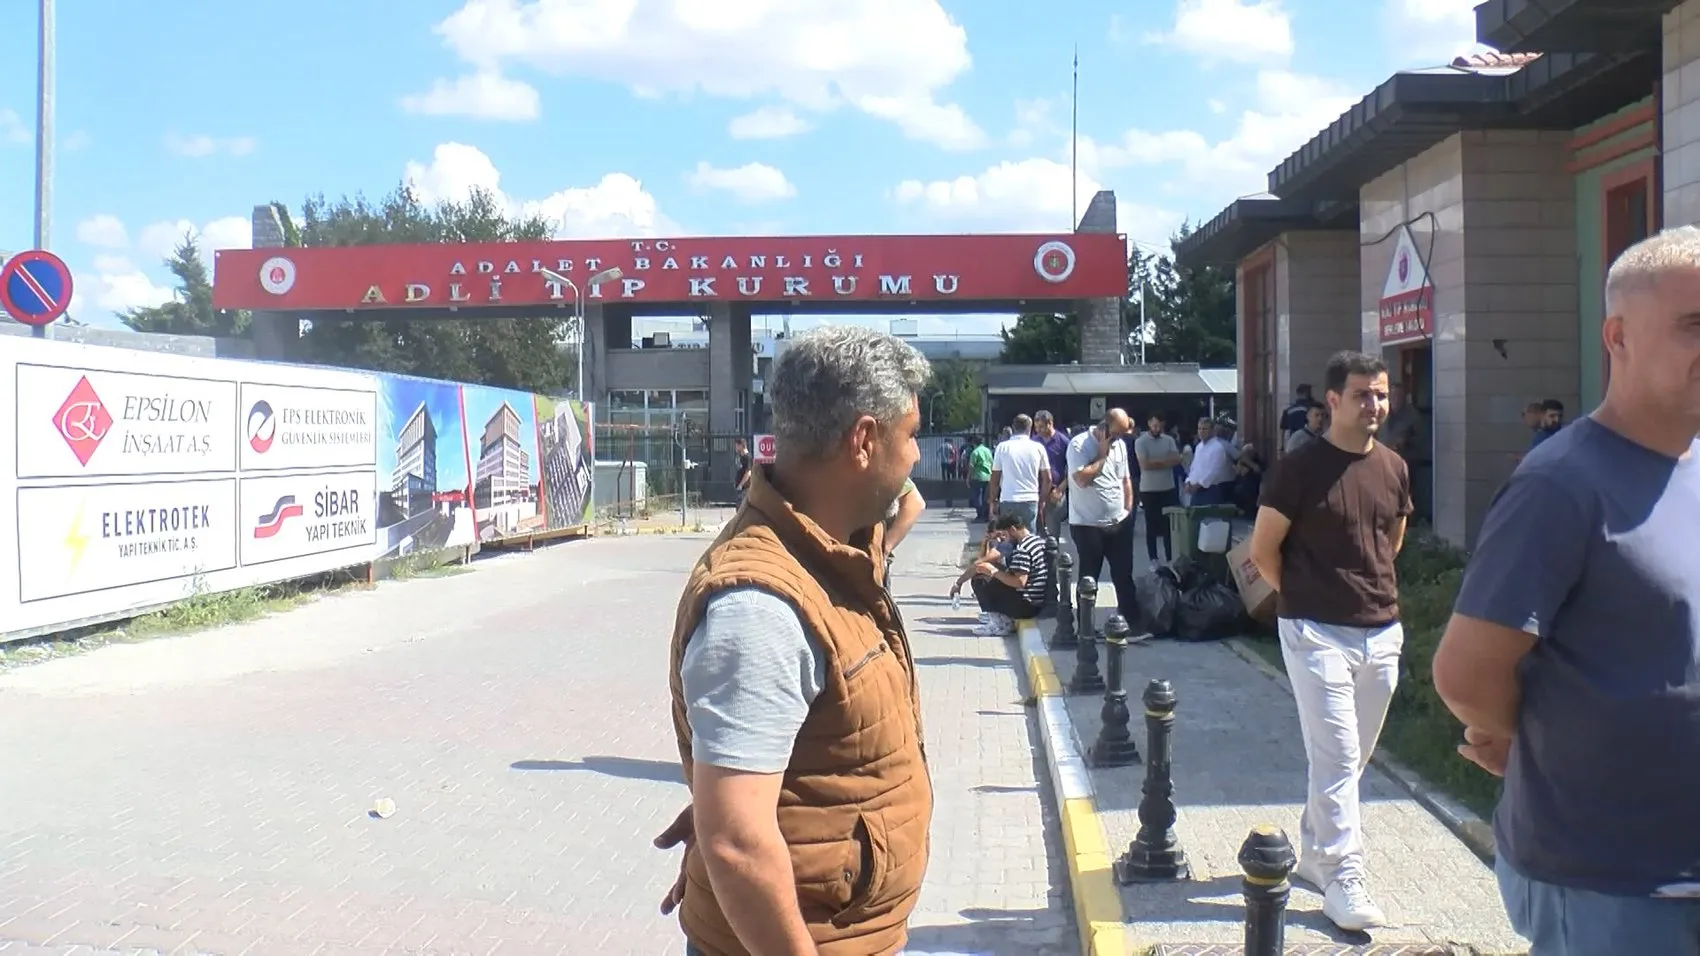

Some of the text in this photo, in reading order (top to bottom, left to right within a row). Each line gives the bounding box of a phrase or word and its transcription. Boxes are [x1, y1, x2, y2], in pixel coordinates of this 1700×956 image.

[631, 240, 676, 252] T.C.
[449, 248, 864, 275] ADALET BAKANLIĞI
[361, 274, 960, 304] ADLİ TIP KURUMU
[122, 393, 212, 423] EPSİLON
[283, 407, 366, 426] EPS ELEKTRONİK
[122, 429, 185, 457] İNŞAAT
[314, 484, 359, 519] SİBAR
[102, 504, 210, 539] ELEKTROTEK
[305, 515, 367, 543] YAPI TEKNİK
[118, 543, 138, 559] YAPI
[138, 538, 167, 556] TEKNİK
